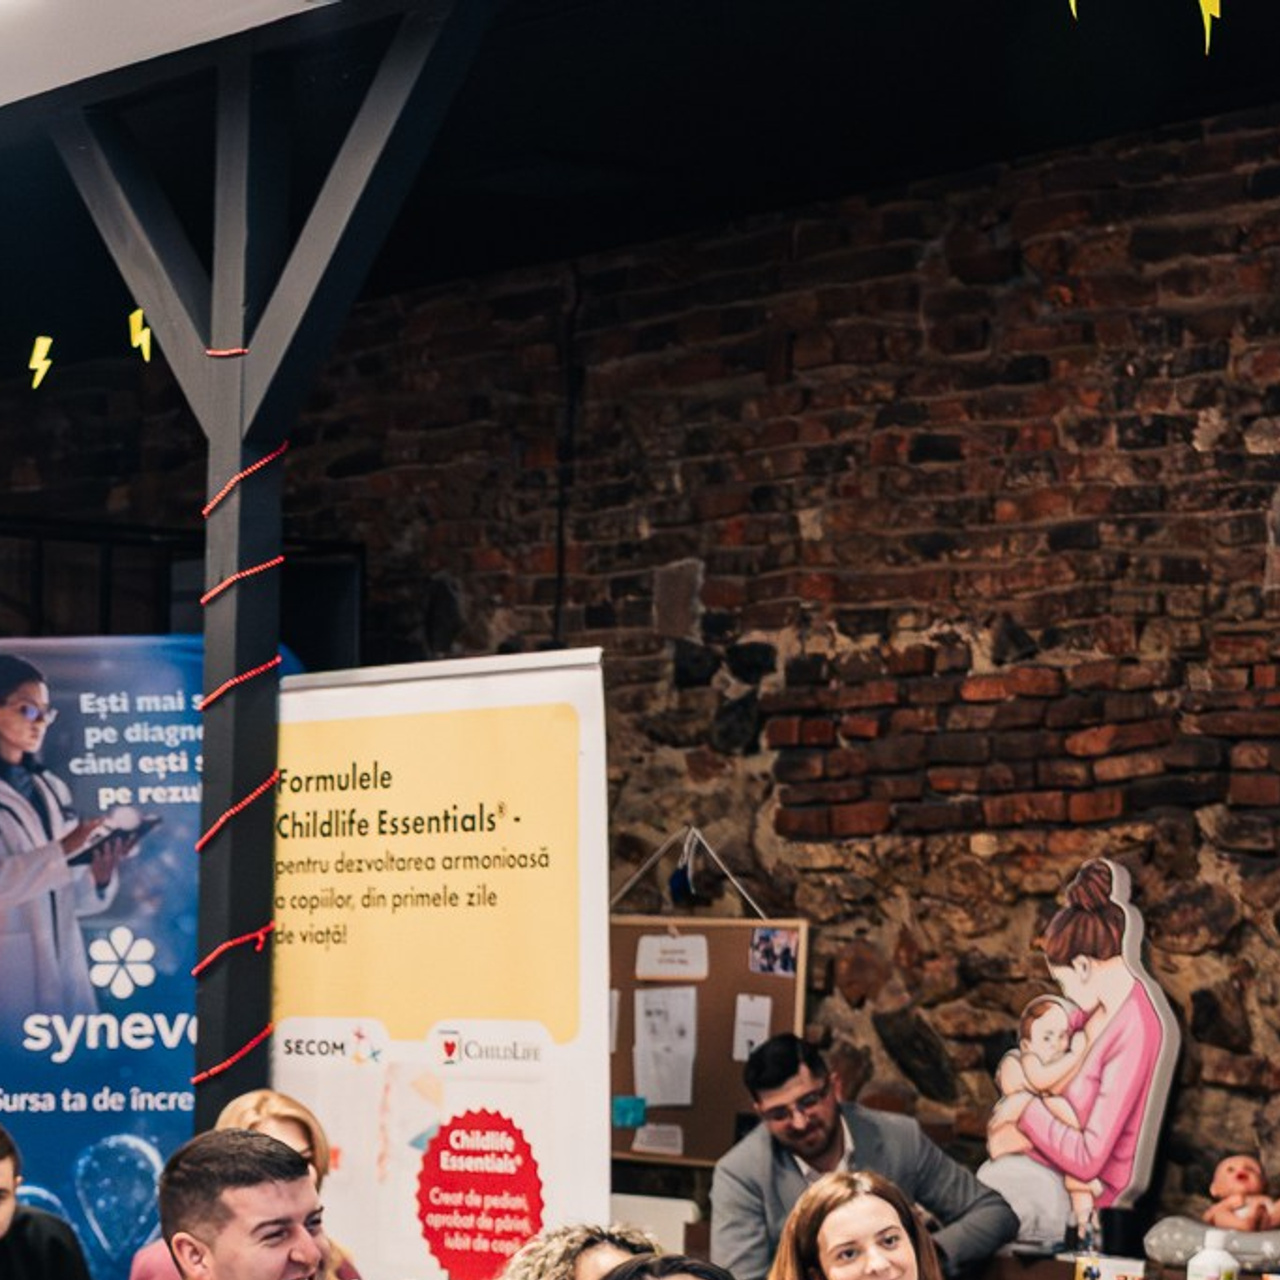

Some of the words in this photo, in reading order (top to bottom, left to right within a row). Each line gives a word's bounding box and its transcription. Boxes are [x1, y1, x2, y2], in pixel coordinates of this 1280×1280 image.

[79, 691, 129, 720] Ești
[136, 690, 185, 712] mai
[84, 726, 118, 749] pe
[69, 752, 131, 775] când
[138, 751, 188, 779] ești
[278, 761, 392, 794] Formulele
[98, 787, 132, 811] pe
[138, 782, 203, 803] rezul
[276, 808, 369, 838] Childlife
[275, 854, 329, 880] pentru
[334, 850, 436, 874] dezvoltarea
[442, 847, 550, 870] armonioasă
[290, 887, 355, 915] copiilor,
[360, 887, 387, 908] din
[392, 885, 459, 914] primele
[466, 884, 497, 906] zile
[275, 926, 294, 944] de
[283, 1039, 346, 1056] SECOM
[61, 1089, 87, 1112] ta
[92, 1086, 125, 1112] de
[130, 1087, 195, 1111] încre
